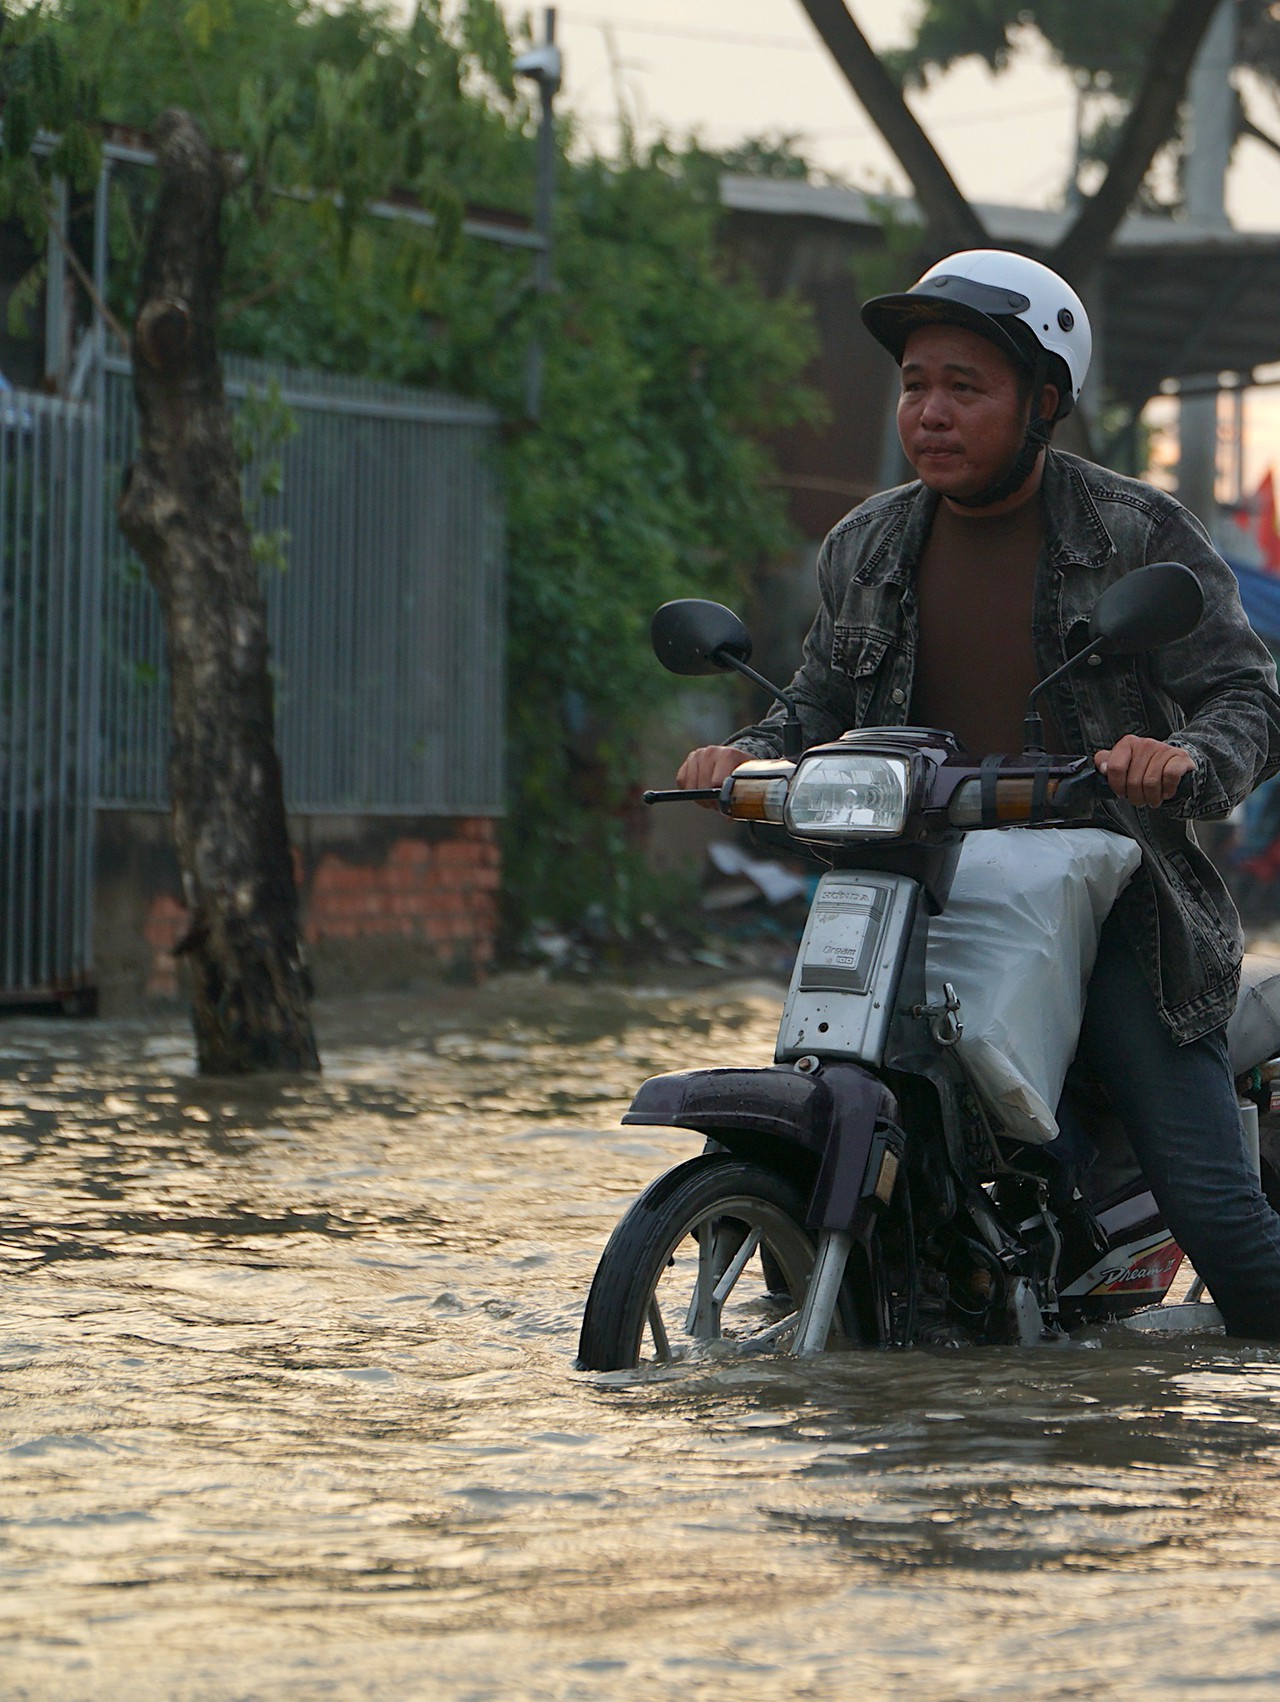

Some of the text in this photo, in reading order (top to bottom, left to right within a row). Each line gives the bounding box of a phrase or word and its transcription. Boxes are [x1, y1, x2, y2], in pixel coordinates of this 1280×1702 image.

[821, 891, 869, 902] HONDA
[823, 945, 856, 956] Dream
[836, 956, 854, 965] 100
[1101, 1266, 1160, 1285] Dream
